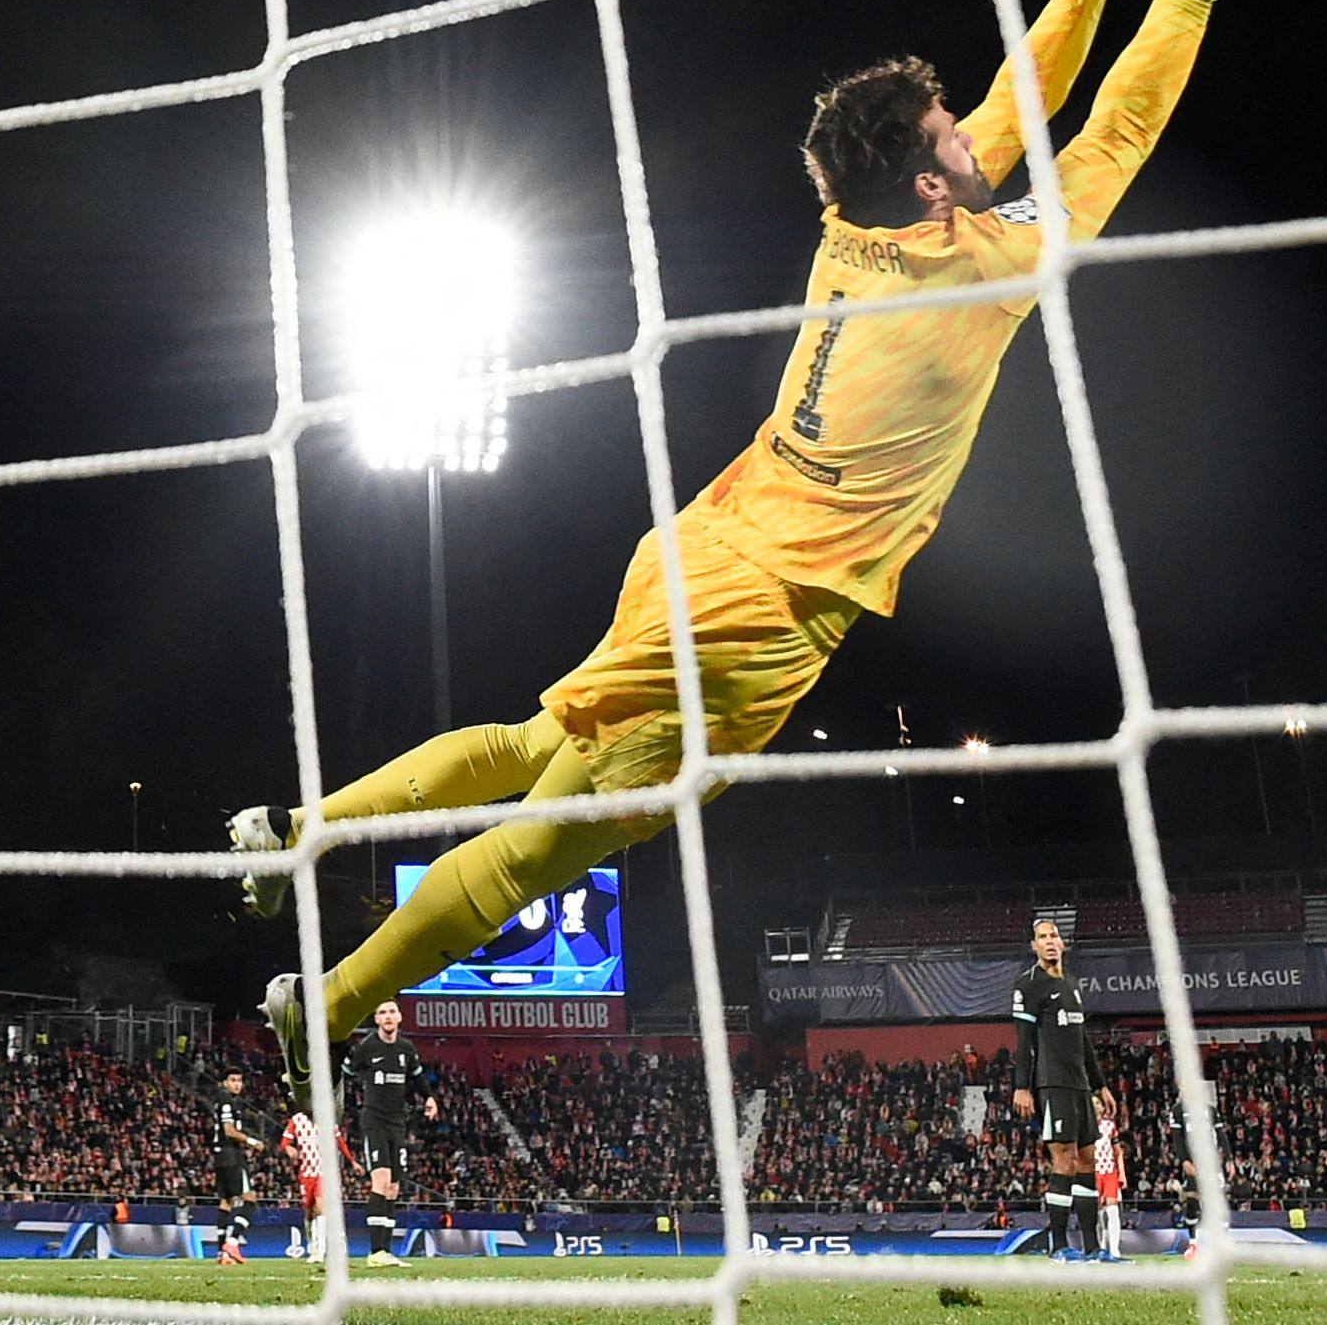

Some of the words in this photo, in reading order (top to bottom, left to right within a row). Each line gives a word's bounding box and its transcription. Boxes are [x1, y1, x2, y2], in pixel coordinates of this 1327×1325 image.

[1107, 972, 1220, 992] CHAMONS
[1226, 969, 1303, 988] LEAGUE
[768, 986, 817, 1003] QATAR
[821, 984, 884, 1000] AIRWAYS
[415, 1001, 487, 1028] GIRONA
[490, 1001, 559, 1029] FUTBOL
[561, 1001, 609, 1029] CLUB
[566, 1235, 603, 1255] PS5
[779, 1235, 851, 1255] PS5
